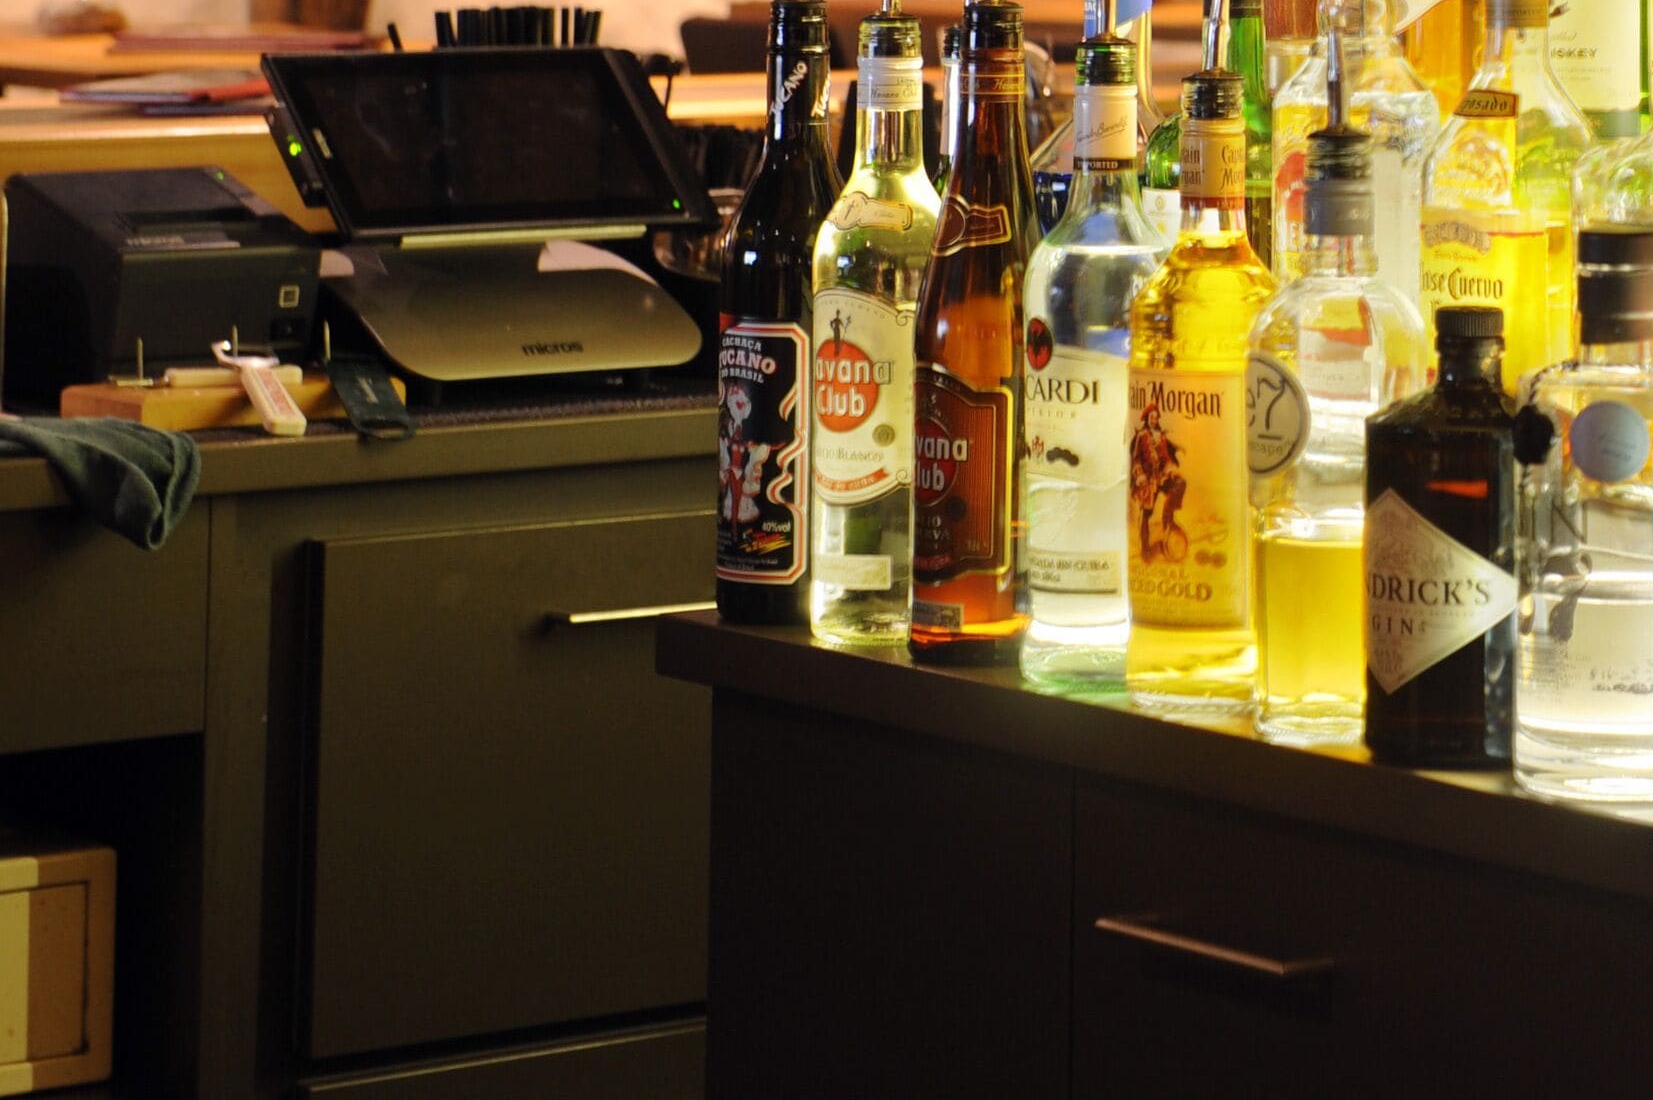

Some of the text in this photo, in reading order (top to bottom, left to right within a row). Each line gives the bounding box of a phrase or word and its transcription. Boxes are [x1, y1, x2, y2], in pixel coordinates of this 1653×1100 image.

[1076, 161, 1119, 170] IPORTED
[1447, 267, 1503, 300] Cuervo
[521, 340, 583, 357] micros
[719, 348, 778, 375] UCANO
[730, 367, 765, 384] BRASIL
[1147, 380, 1222, 420] Morgan
[1366, 573, 1491, 606] DRICK'S
[1371, 614, 1414, 636] GIN
